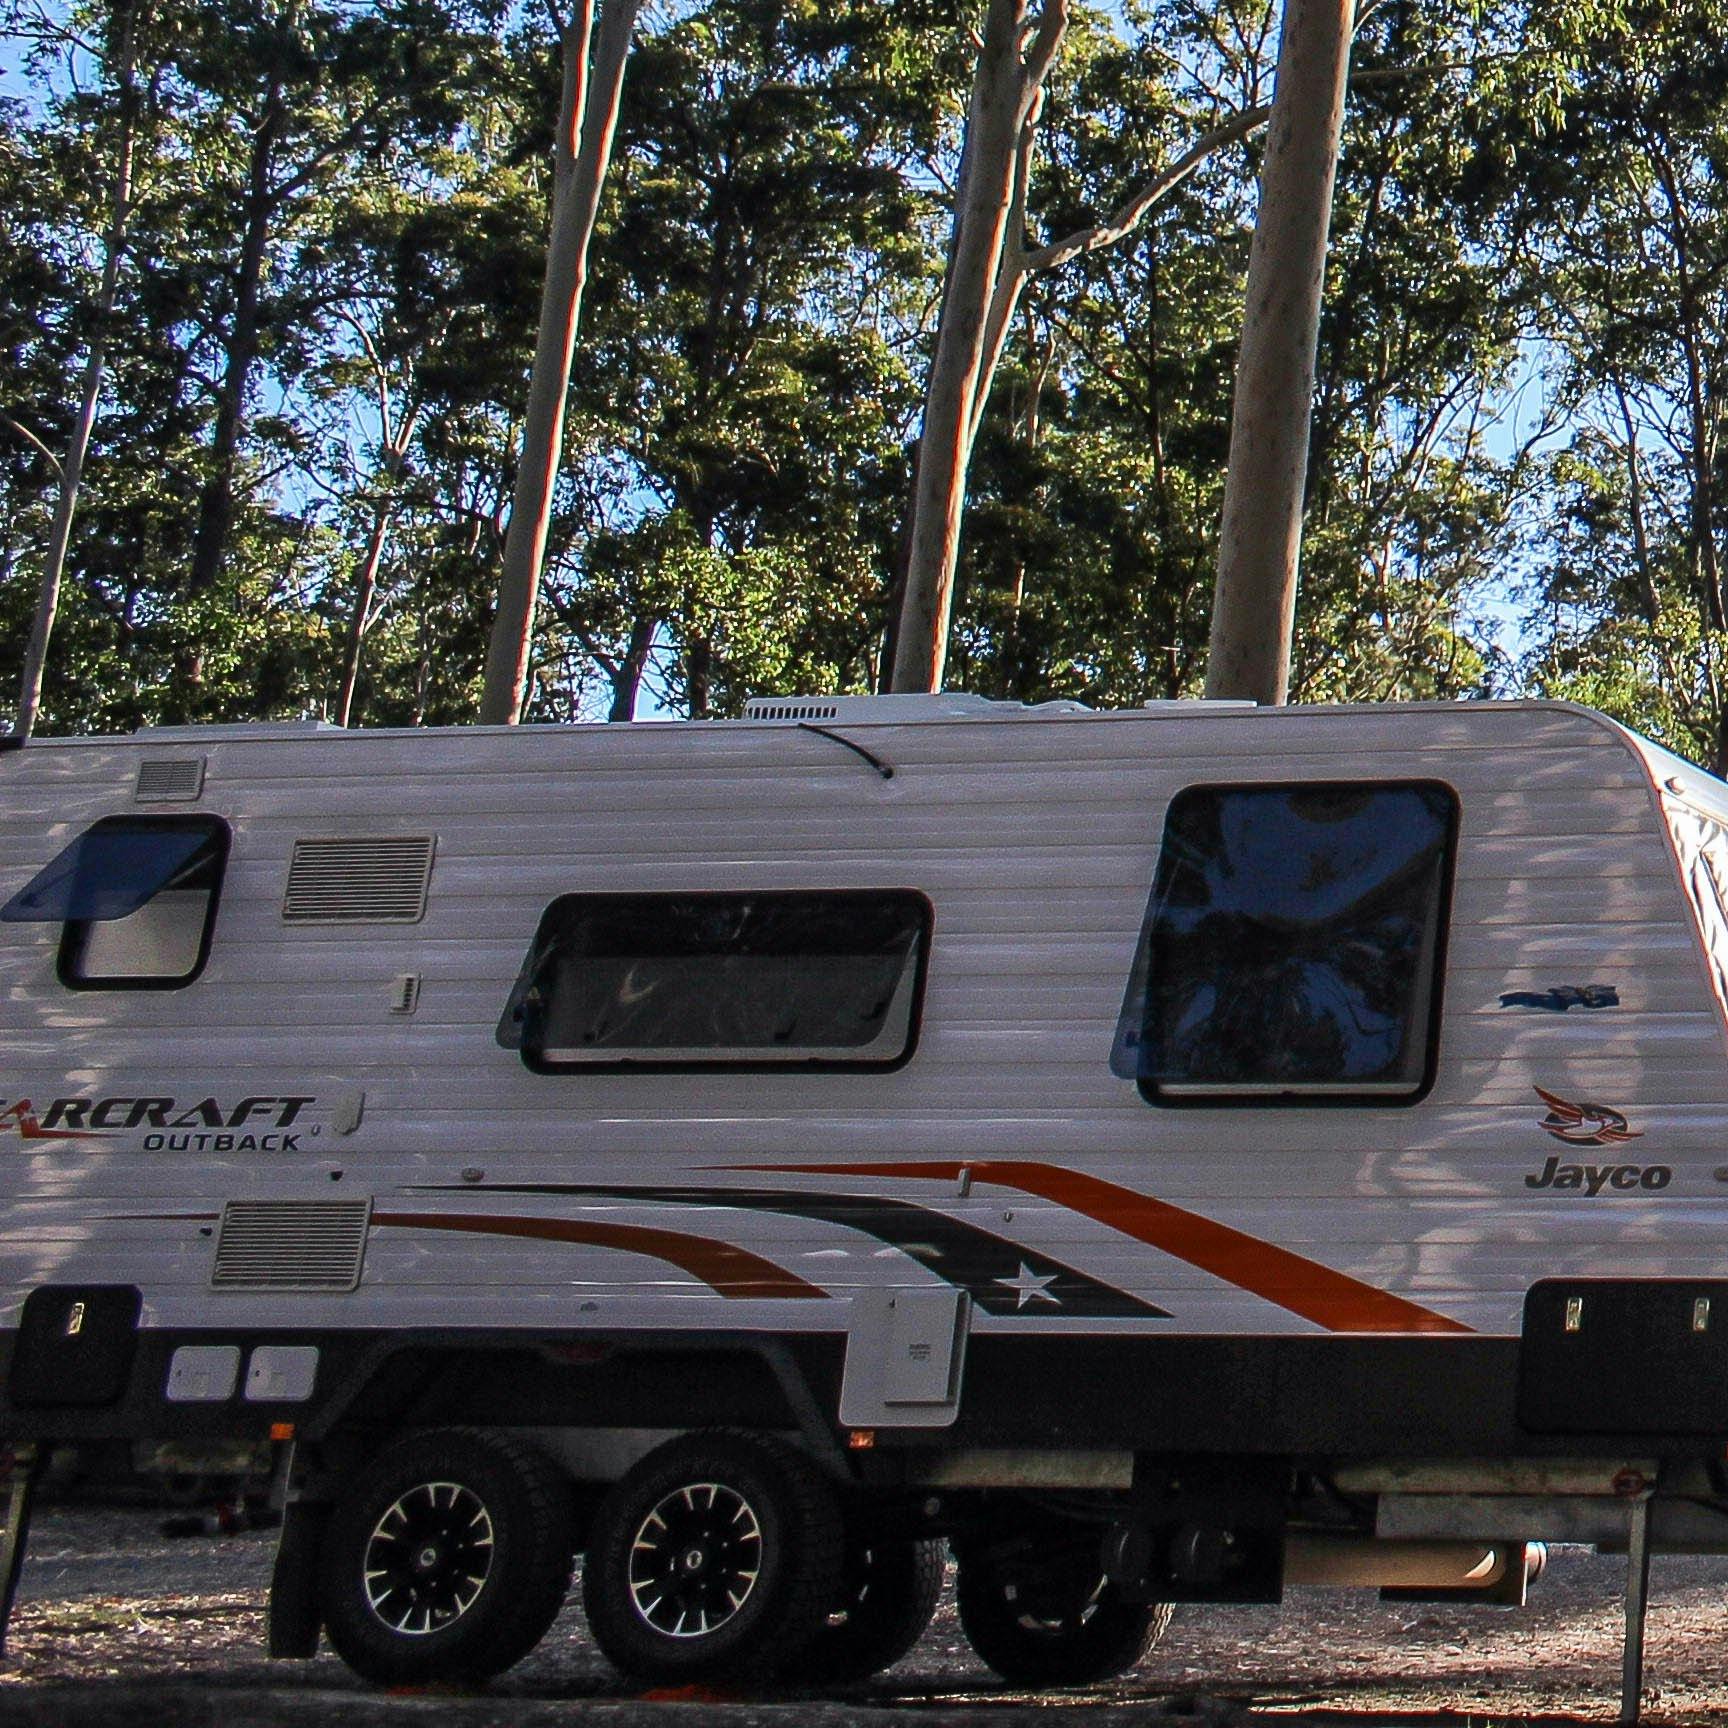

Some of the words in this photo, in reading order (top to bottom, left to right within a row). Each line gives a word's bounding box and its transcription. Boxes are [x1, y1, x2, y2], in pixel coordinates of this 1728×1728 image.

[0, 1097, 316, 1138] ARCRAFT
[143, 1134, 301, 1151] OUTBACK
[1524, 1156, 1673, 1197] Jayco
